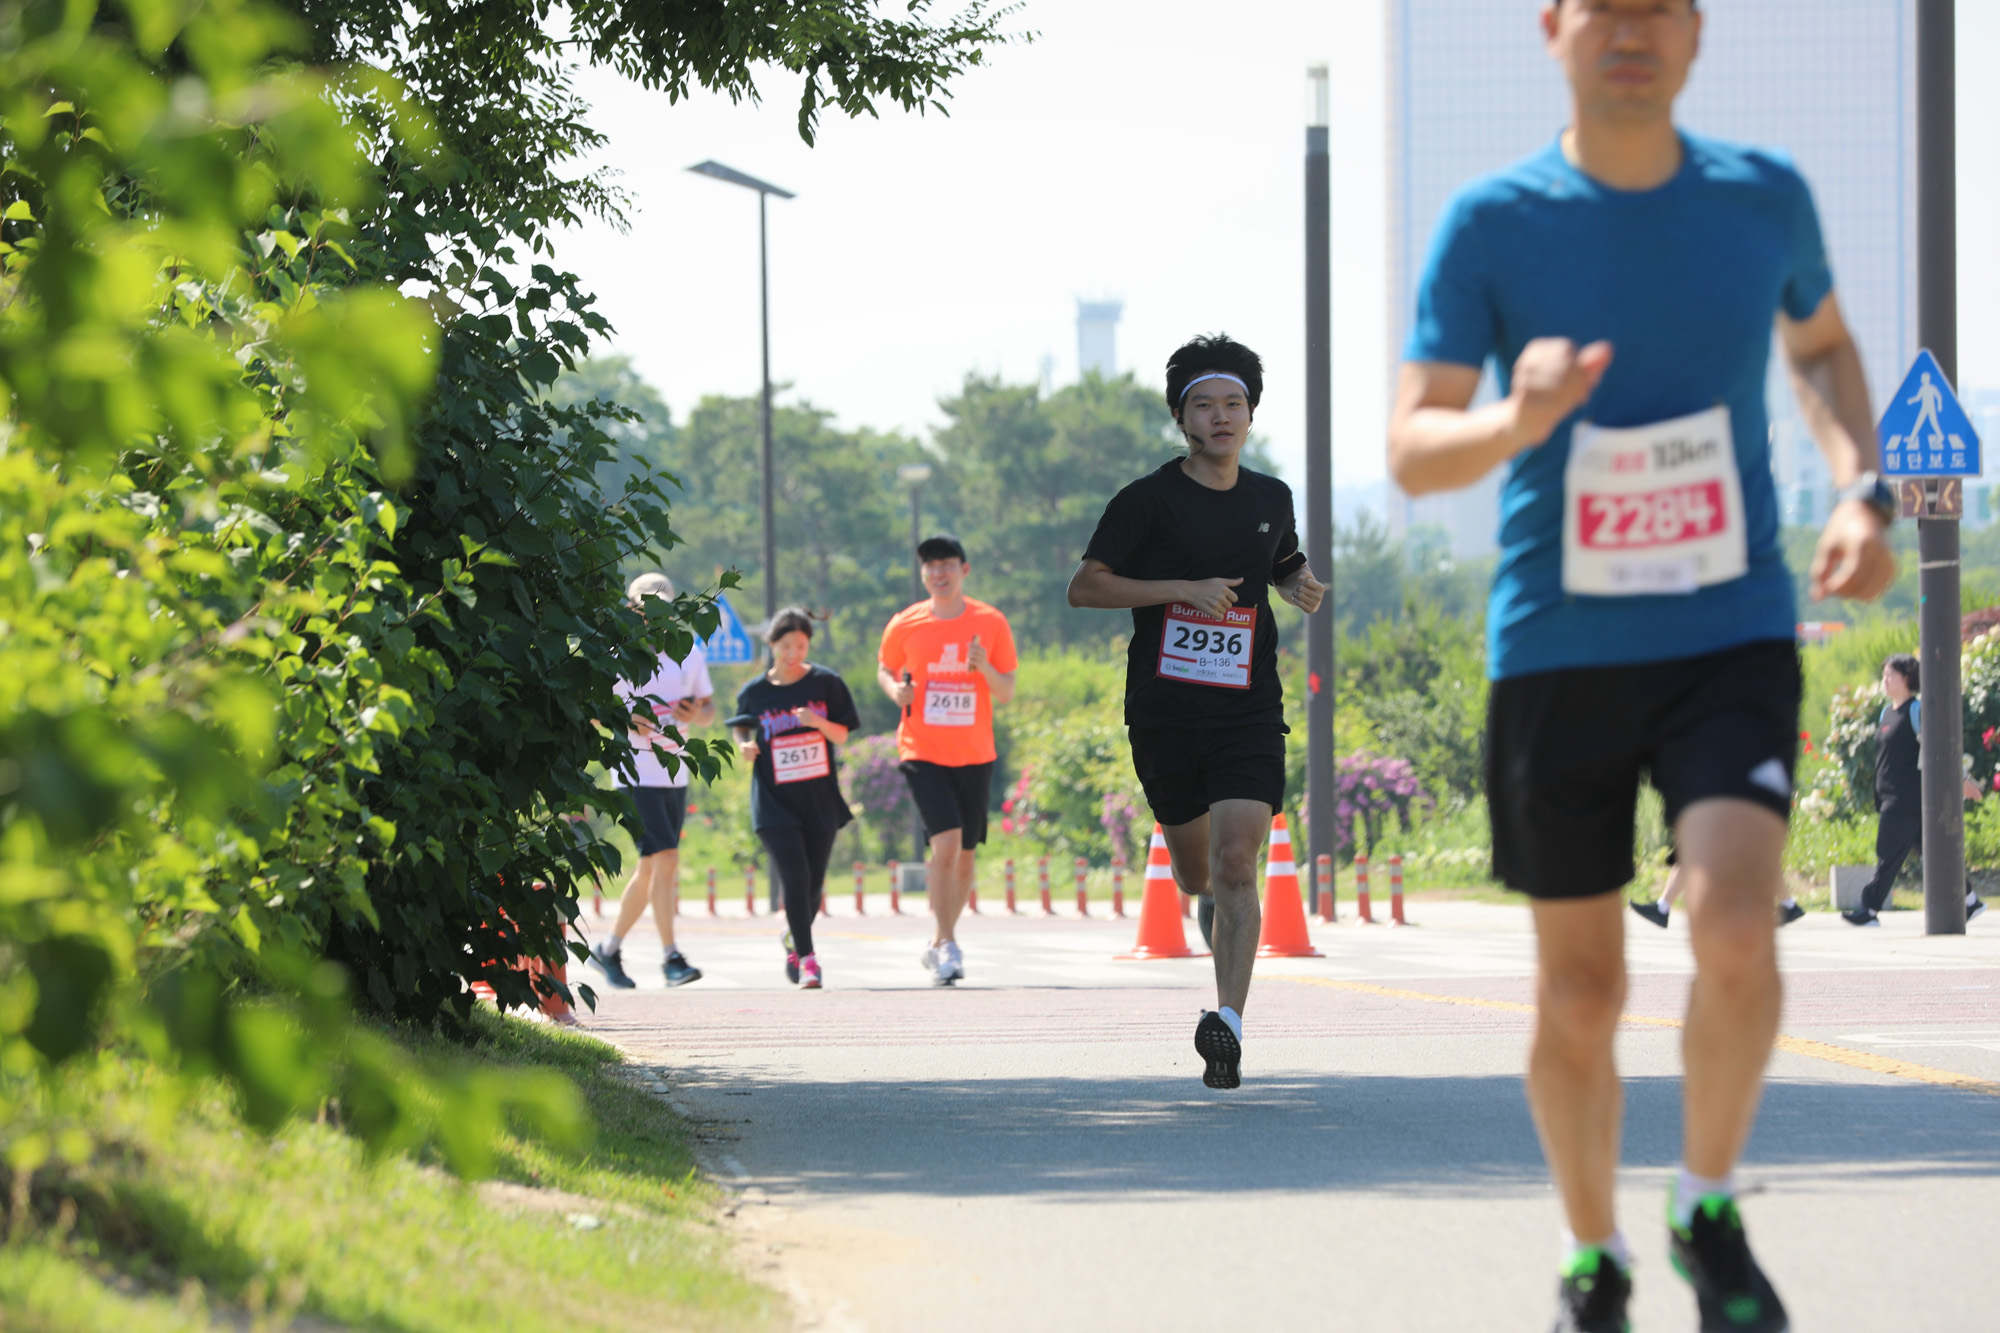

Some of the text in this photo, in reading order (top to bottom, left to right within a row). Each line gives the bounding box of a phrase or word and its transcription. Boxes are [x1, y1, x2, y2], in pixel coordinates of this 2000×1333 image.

[1886, 452, 1966, 470] 횡단보도
[1589, 489, 1716, 543] 2284
[1226, 610, 1250, 622] Run
[1173, 626, 1242, 655] 2936
[1199, 657, 1231, 667] B-136
[931, 694, 971, 709] 2618
[780, 746, 819, 765] 2617
